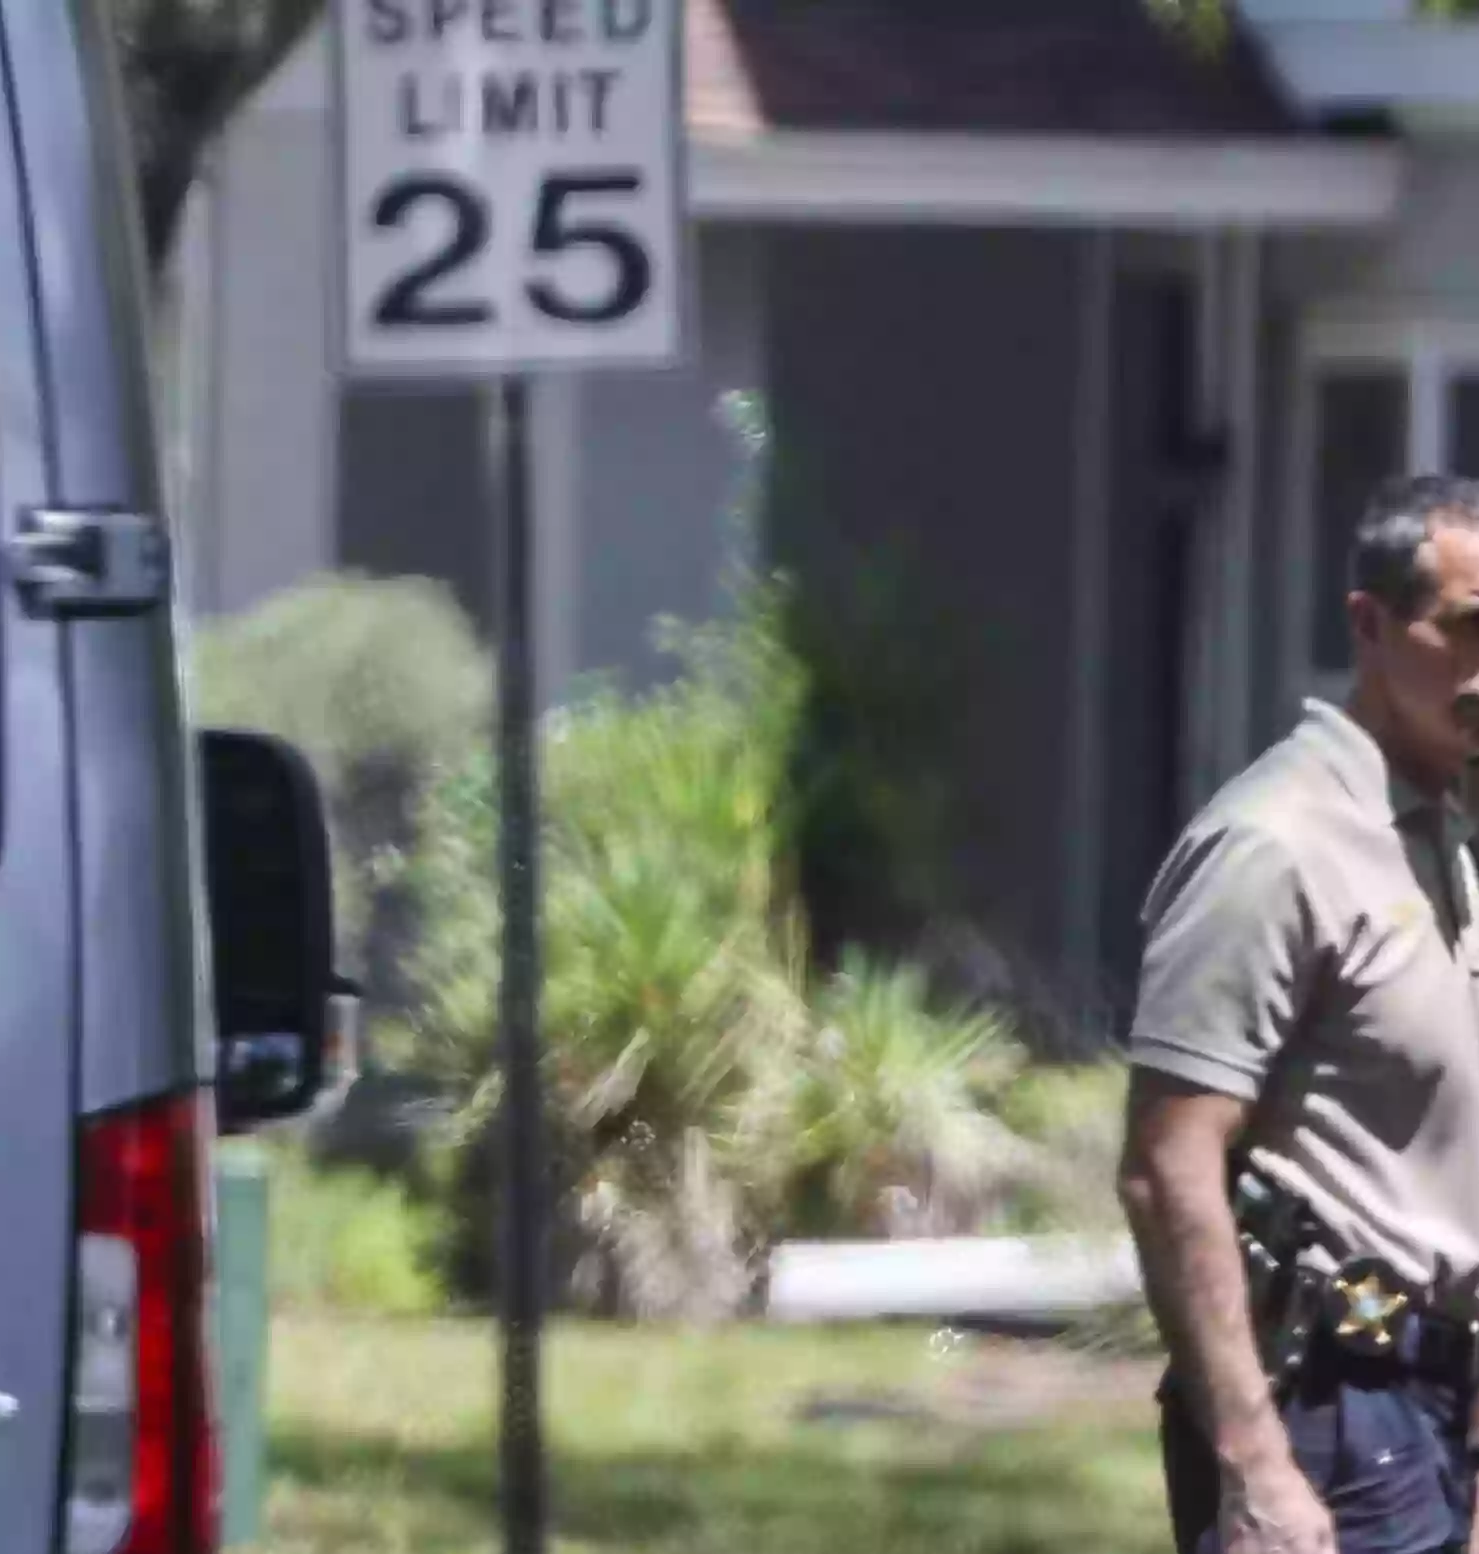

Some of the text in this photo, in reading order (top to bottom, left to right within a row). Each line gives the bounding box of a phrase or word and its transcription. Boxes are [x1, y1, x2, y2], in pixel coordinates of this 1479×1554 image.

[368, 0, 652, 43] SPEED
[399, 69, 623, 136] LIMIT
[373, 165, 652, 325] 25
